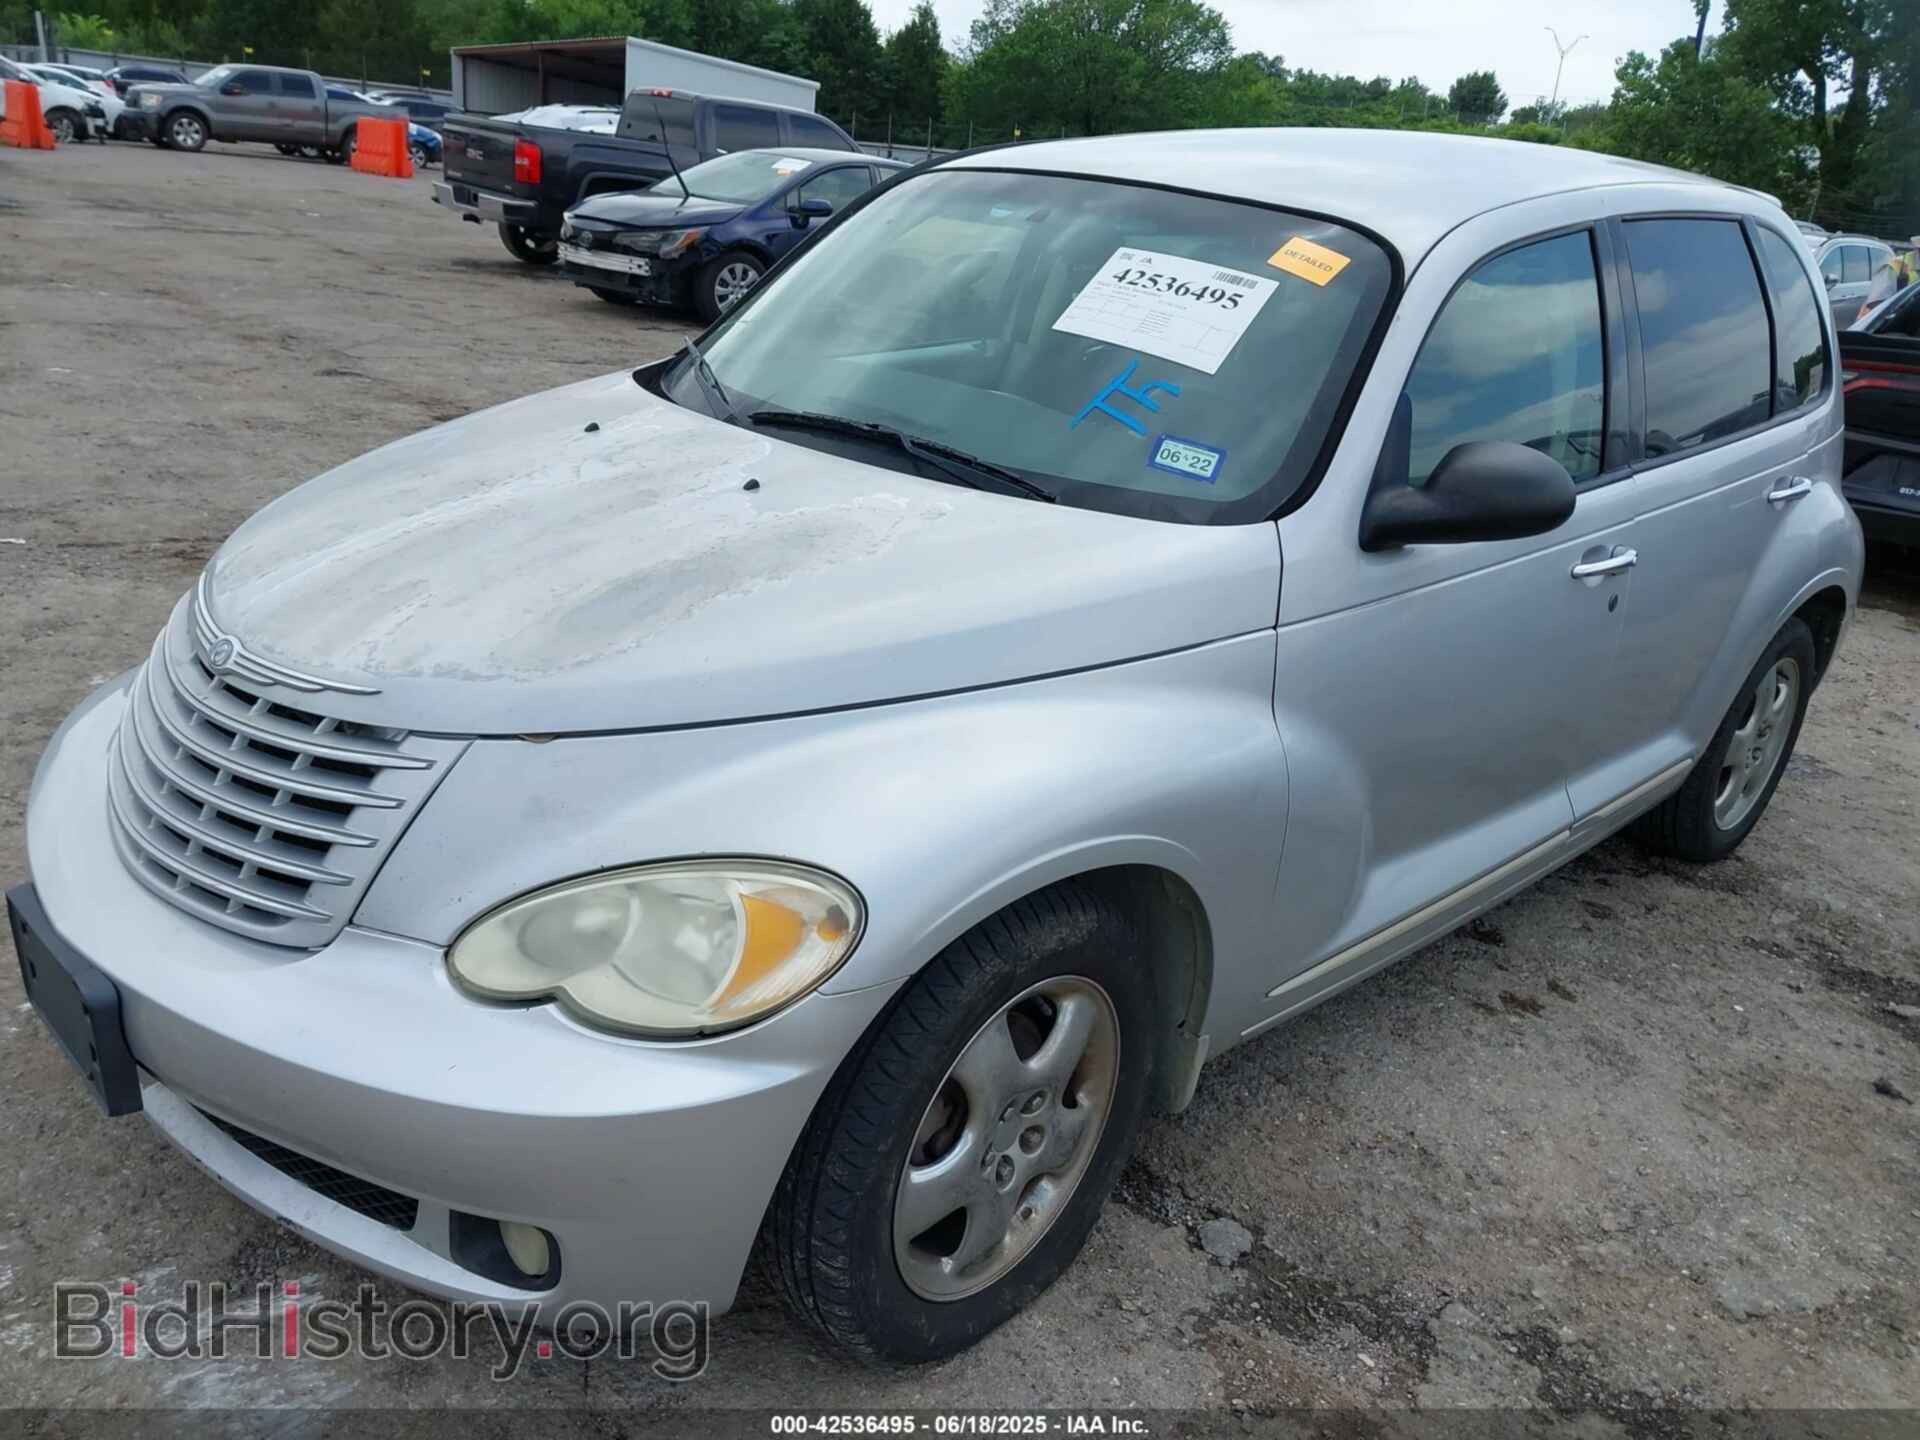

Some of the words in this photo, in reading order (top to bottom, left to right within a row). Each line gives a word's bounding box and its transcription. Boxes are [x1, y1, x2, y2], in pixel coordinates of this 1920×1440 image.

[1283, 248, 1334, 273] DETAILED
[1112, 268, 1245, 310] 42536495
[1160, 447, 1182, 464] 06
[1189, 455, 1212, 473] 22
